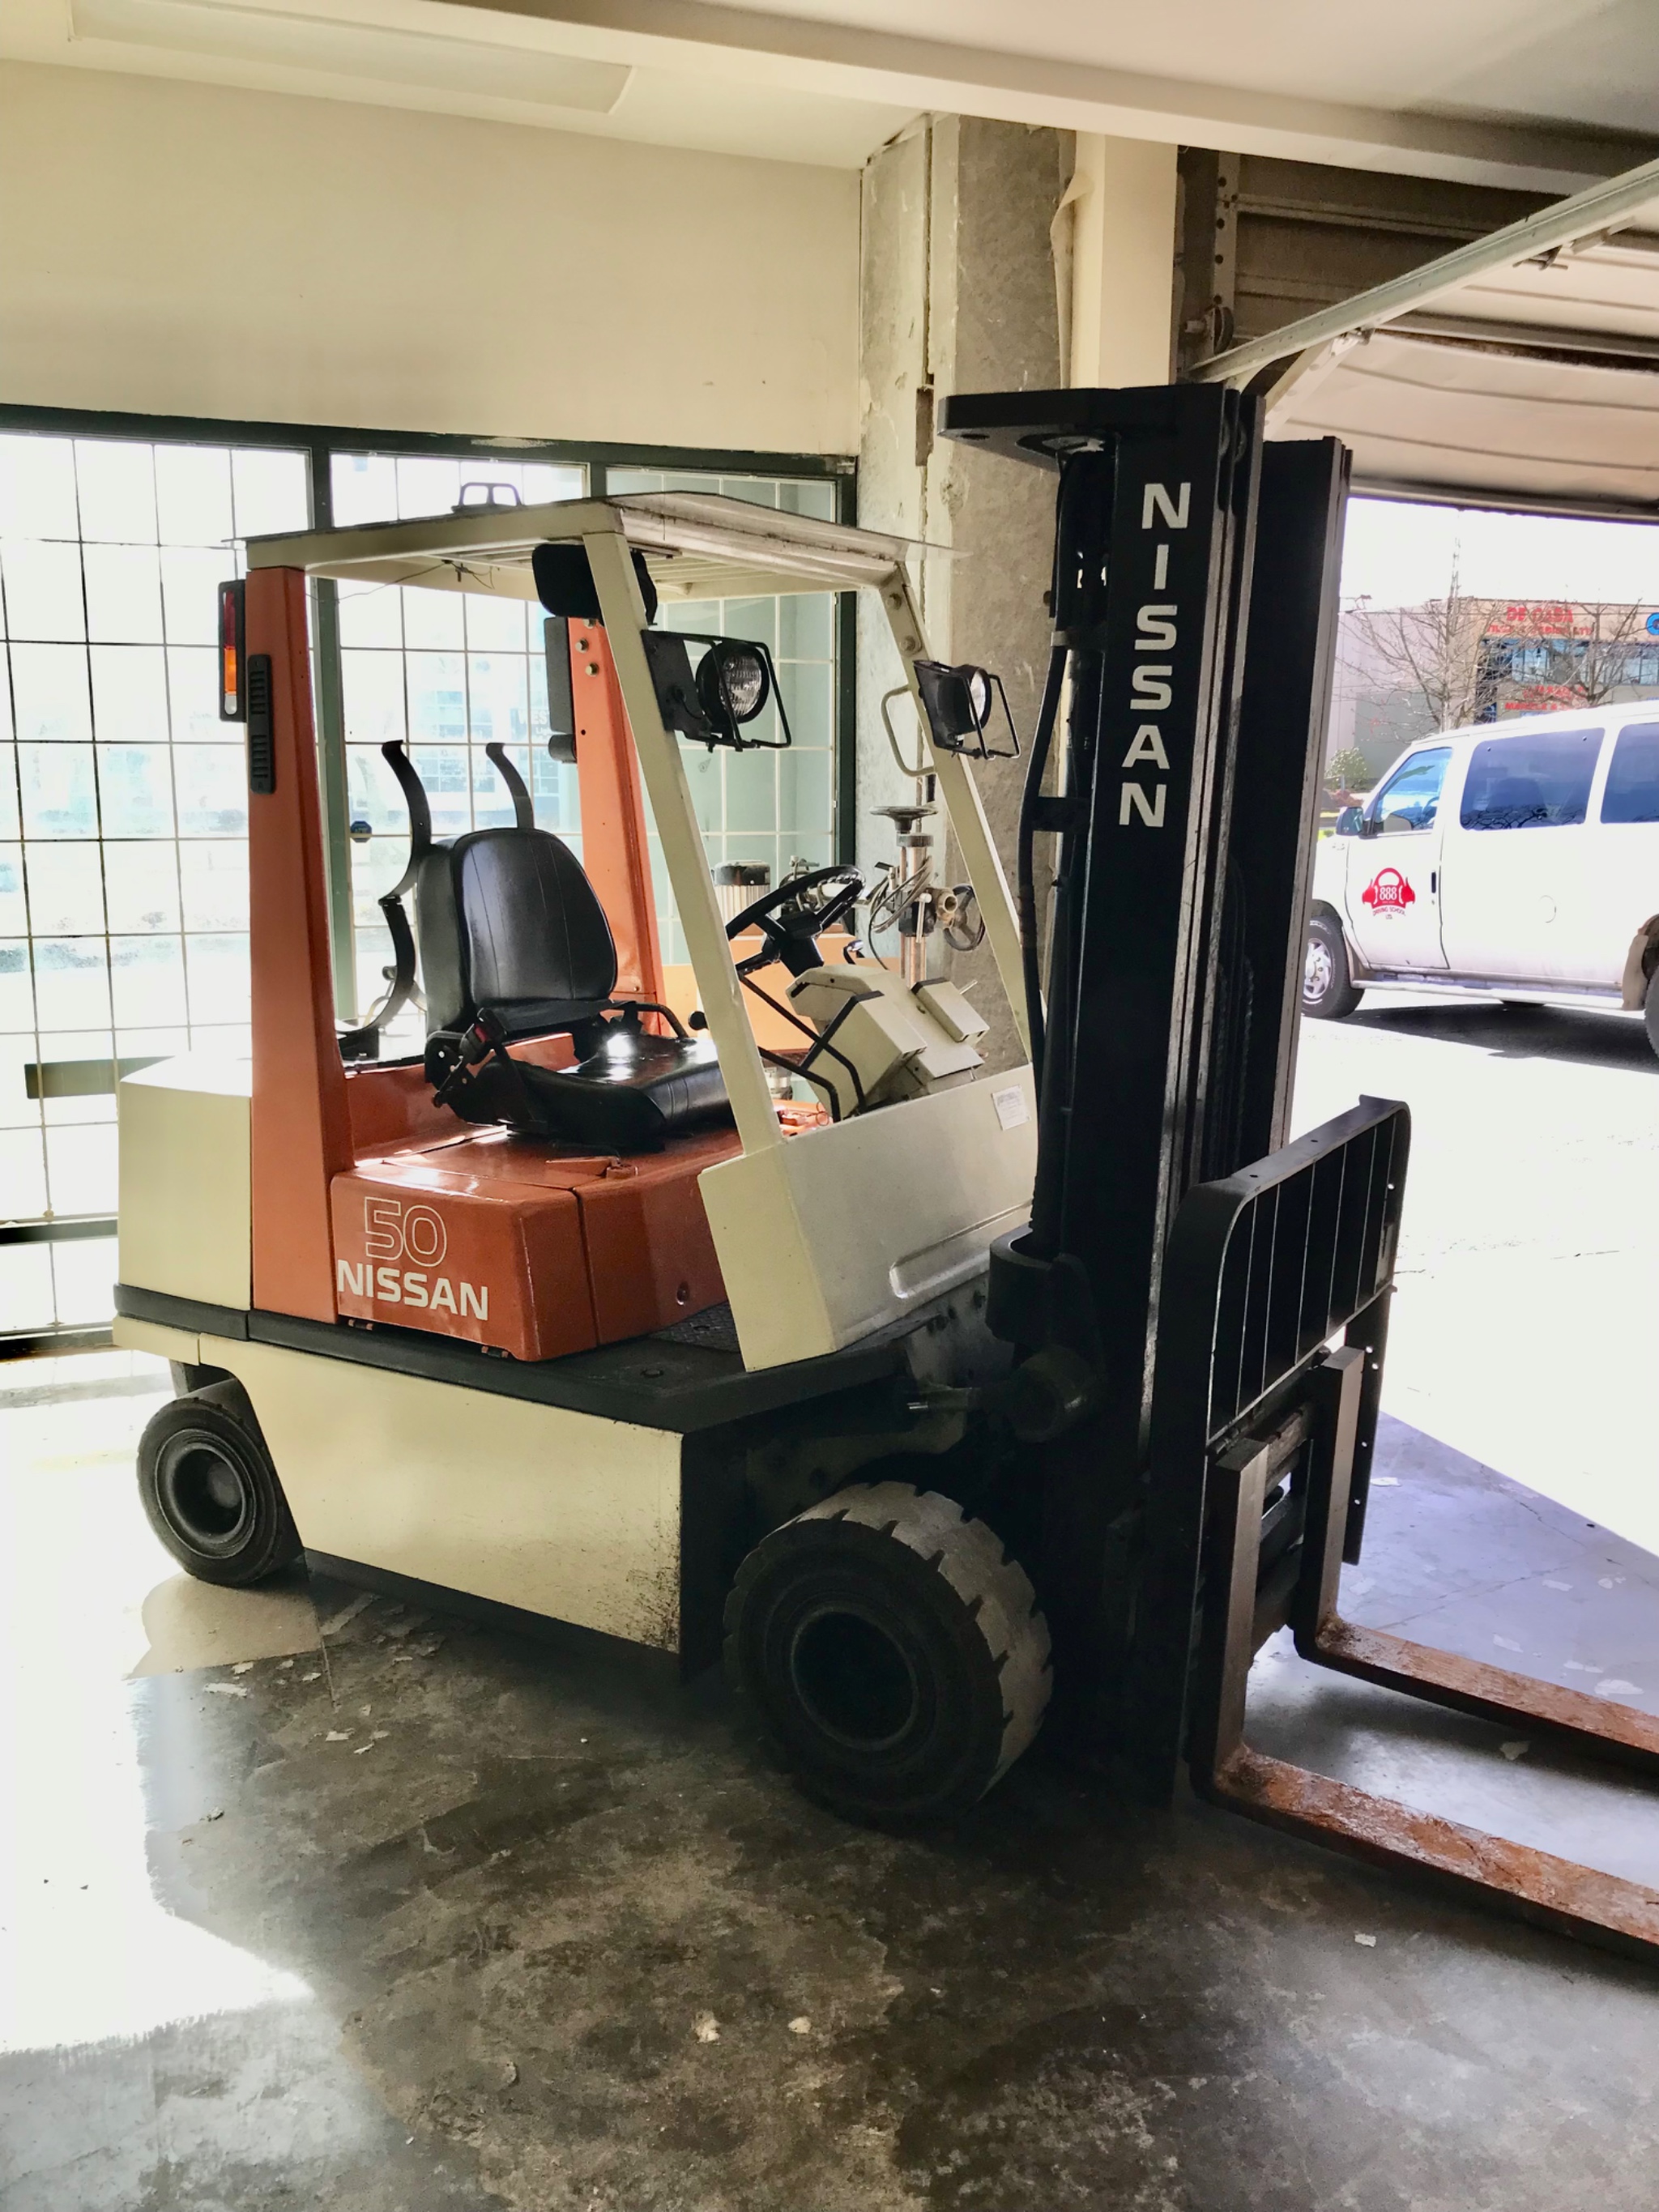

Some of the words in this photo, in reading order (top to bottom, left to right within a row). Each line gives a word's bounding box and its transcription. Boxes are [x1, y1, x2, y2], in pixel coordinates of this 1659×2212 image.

[1119, 483, 1191, 828] NISSAN
[1372, 906, 1388, 917] DRIVING
[1389, 906, 1406, 917] SCHOOL
[1380, 887, 1397, 901] 888
[365, 1196, 447, 1268] 50
[338, 1259, 488, 1321] NISSAN
